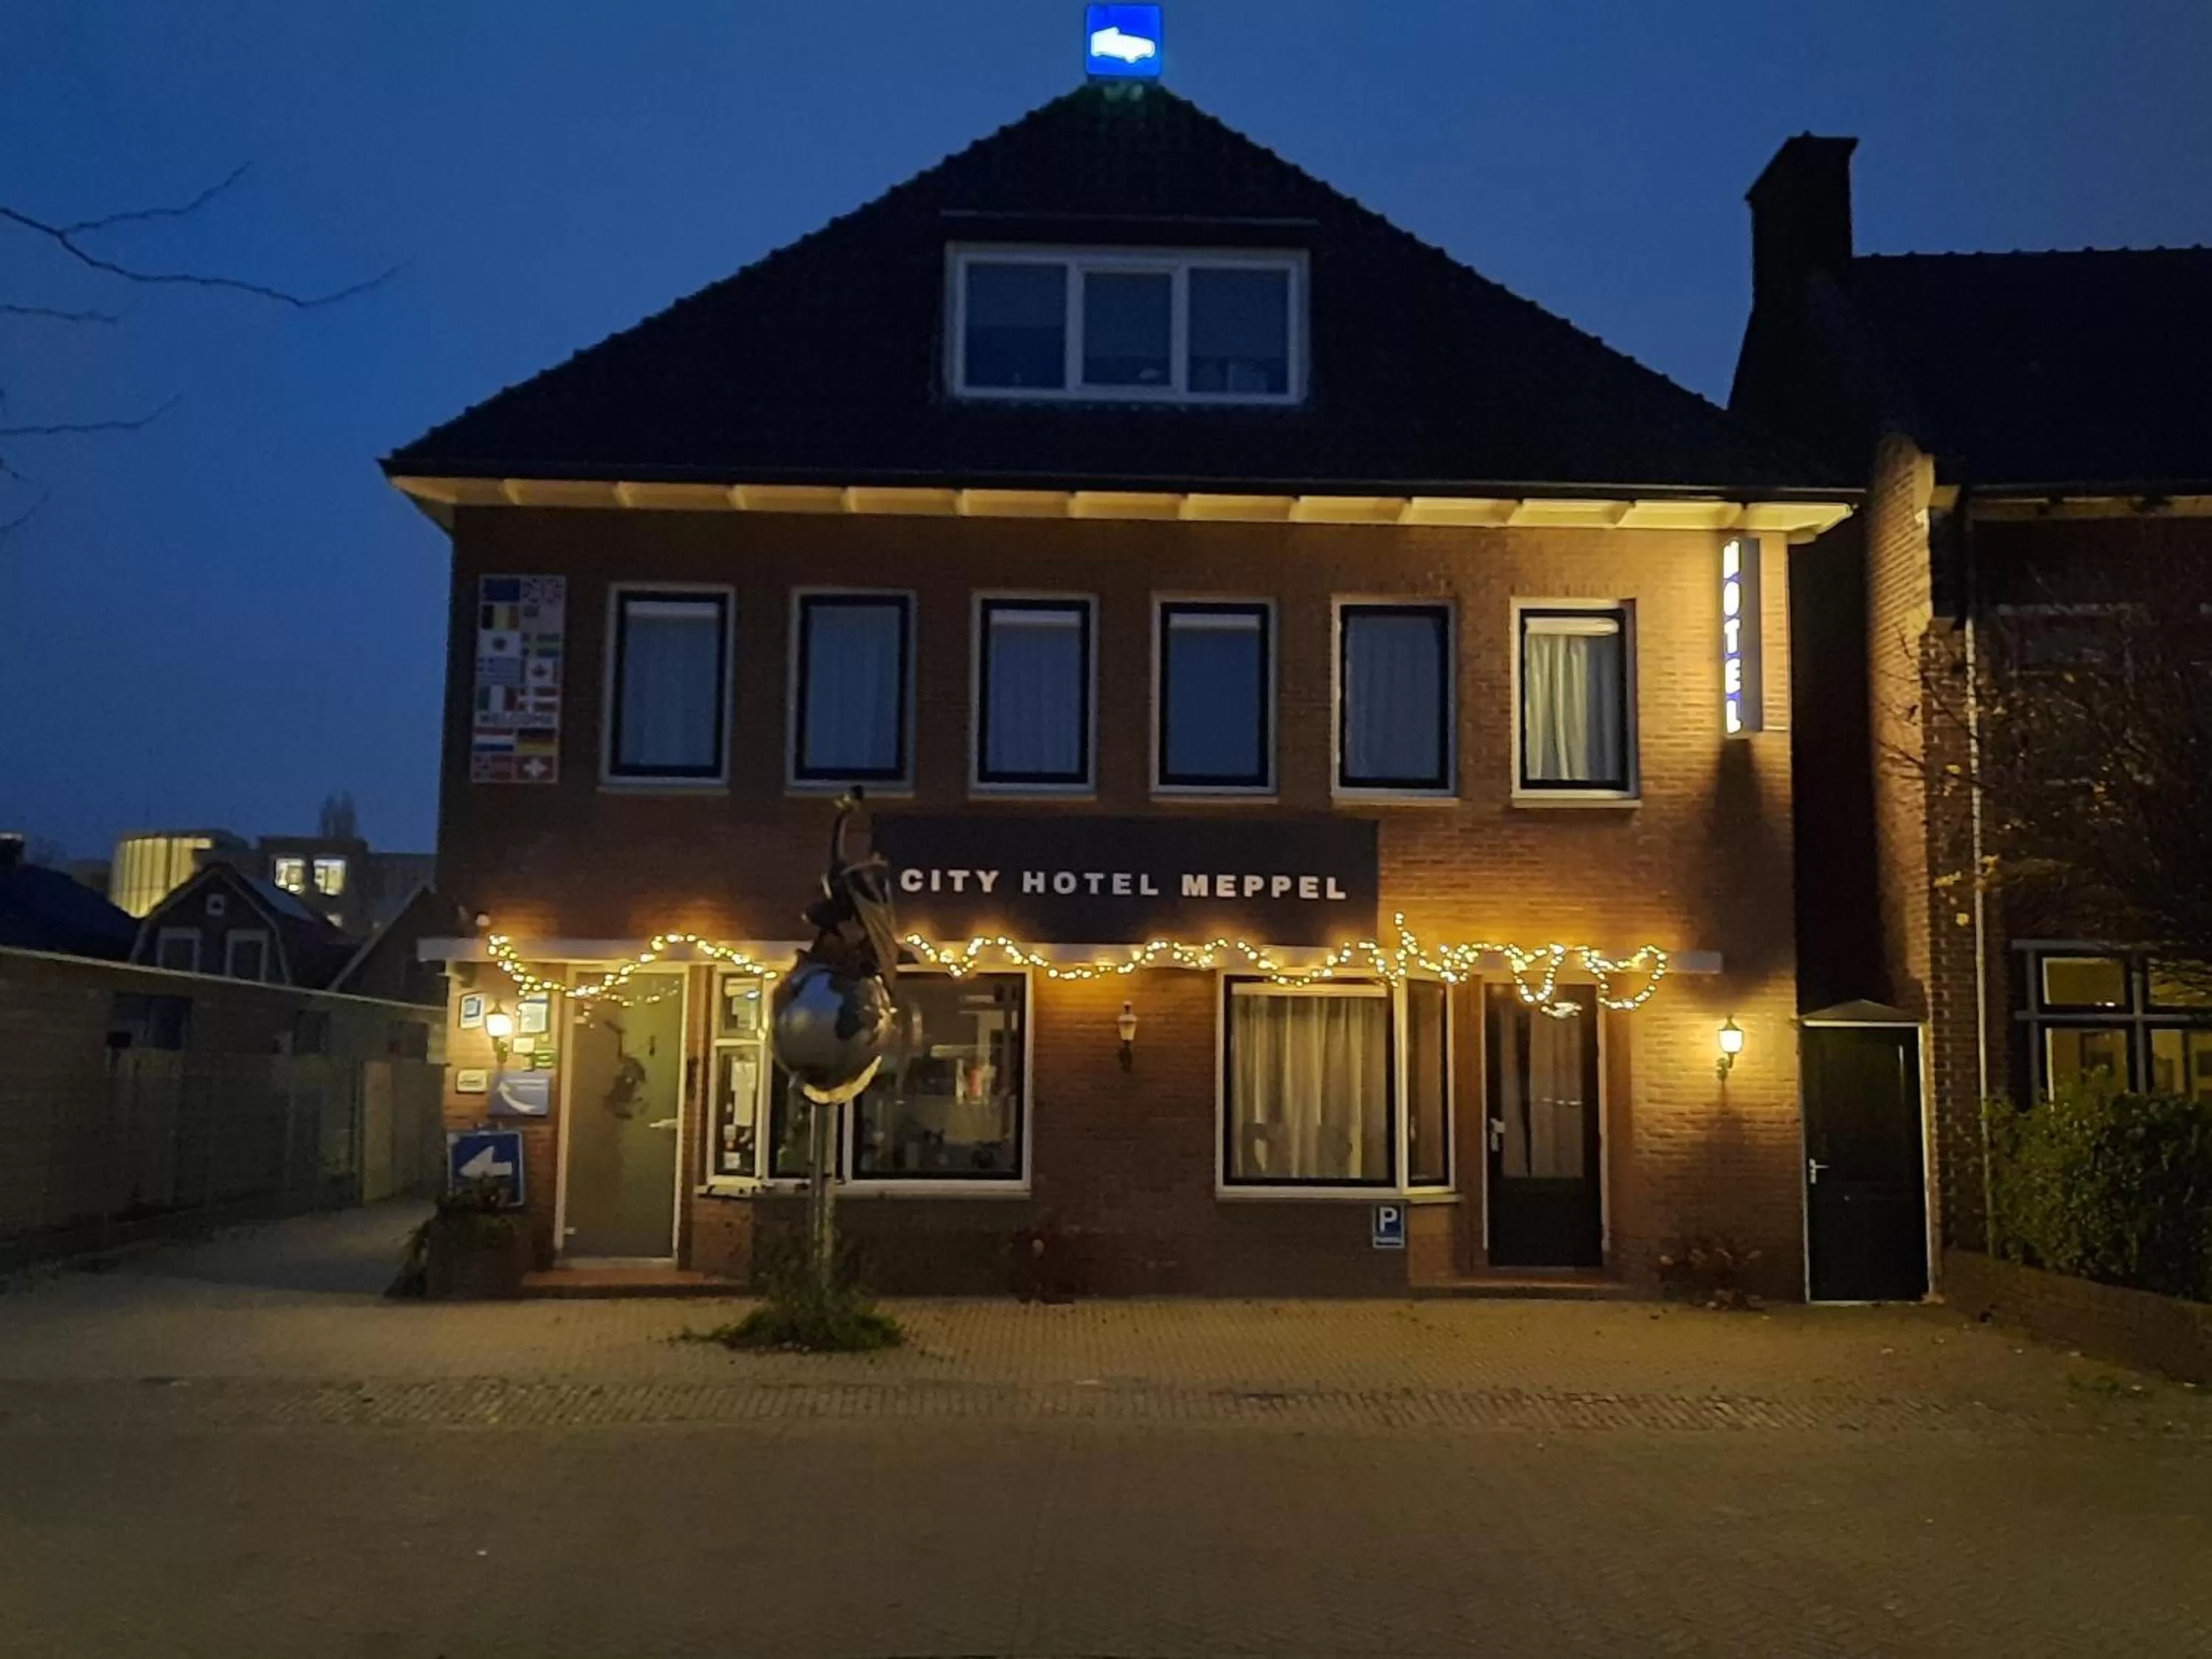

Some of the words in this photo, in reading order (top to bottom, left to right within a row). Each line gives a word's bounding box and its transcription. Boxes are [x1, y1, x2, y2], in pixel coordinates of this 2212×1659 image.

[900, 869, 999, 892] CITY
[1022, 871, 1159, 895] HOTEL
[1181, 873, 1347, 900] MEPPEL
[1380, 1206, 1398, 1232] P
